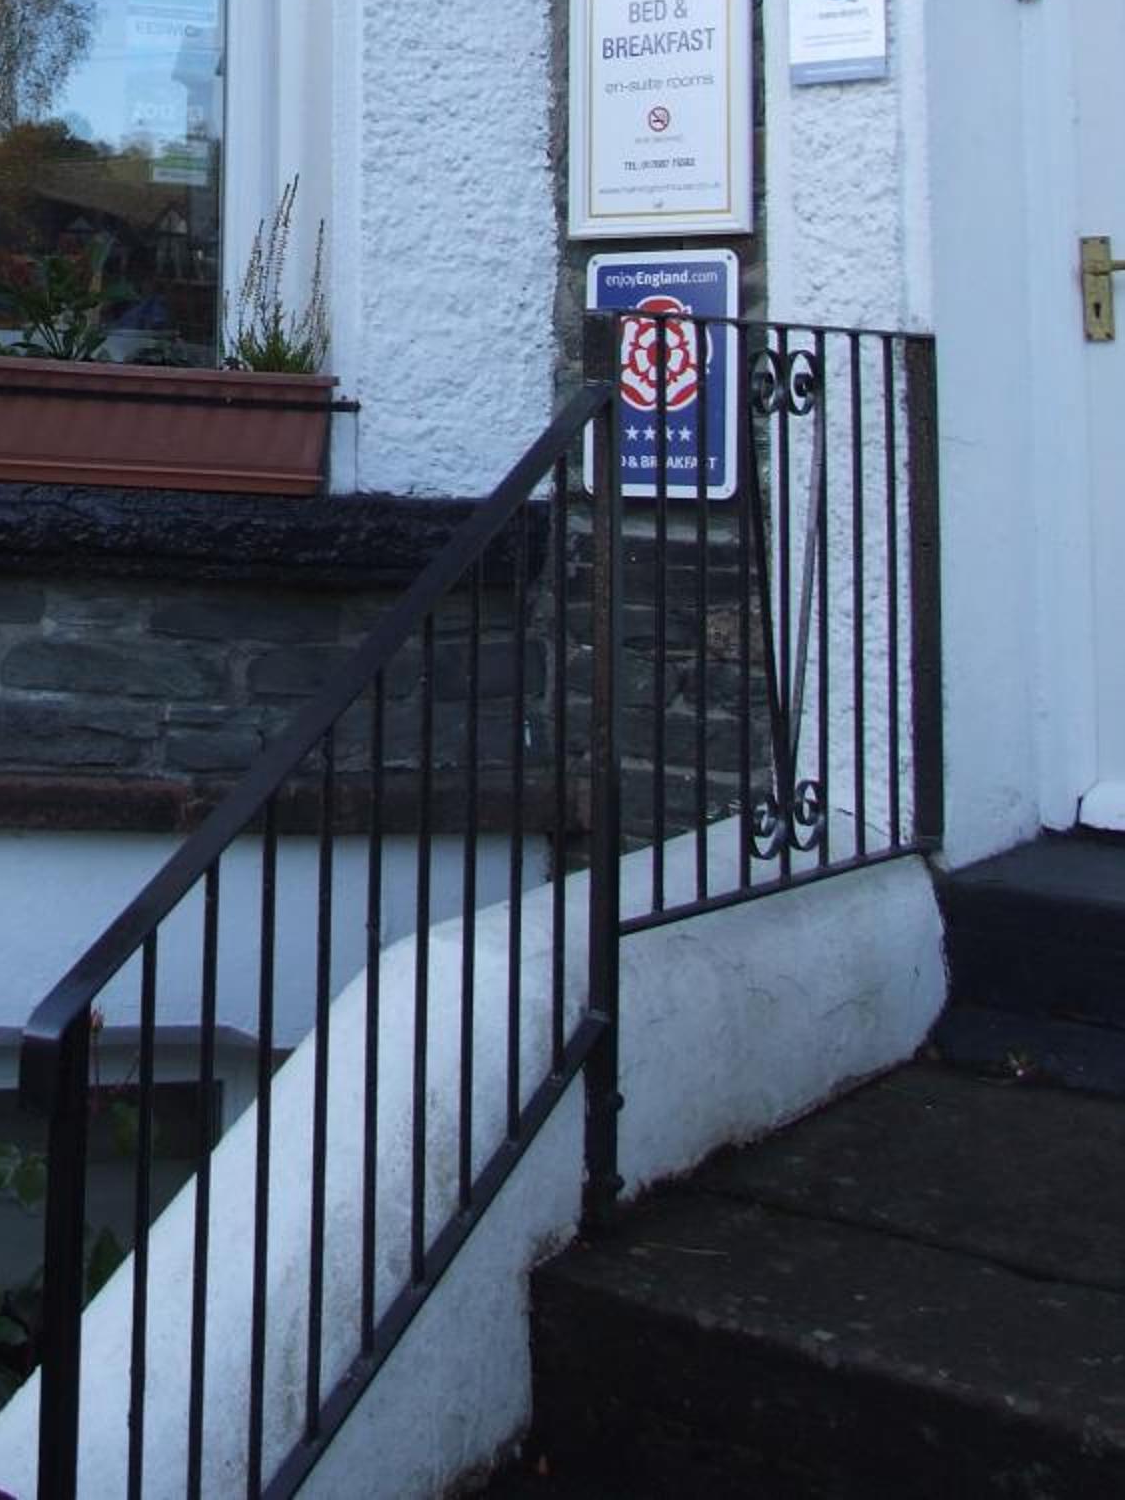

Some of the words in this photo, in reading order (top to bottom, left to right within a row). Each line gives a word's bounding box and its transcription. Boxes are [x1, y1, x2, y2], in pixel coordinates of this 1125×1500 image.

[627, 0, 667, 24] BED
[601, 27, 715, 59] BREAKFAST
[666, 73, 714, 89] rooms
[605, 270, 719, 288] enjoyEngland.com
[640, 456, 718, 469] BRAKFAT
